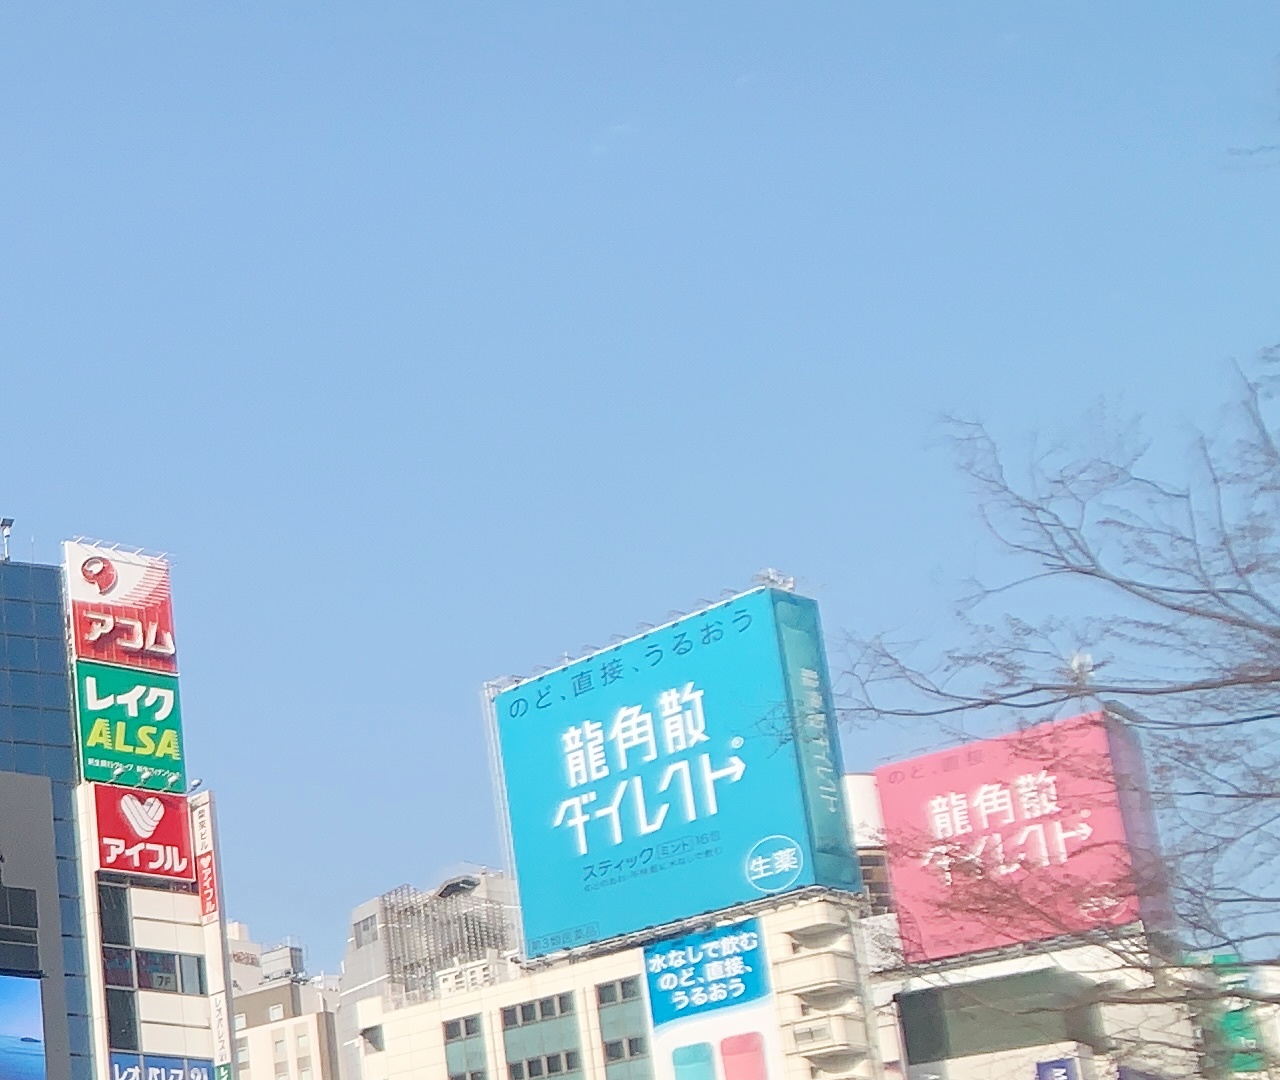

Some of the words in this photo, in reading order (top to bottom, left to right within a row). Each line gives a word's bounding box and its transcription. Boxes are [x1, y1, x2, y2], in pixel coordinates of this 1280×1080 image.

[83, 610, 176, 656] アコム
[509, 608, 754, 719] のど、直接、うるおう
[85, 676, 175, 722] レイク
[87, 717, 182, 761] ALSA
[560, 681, 710, 789] 龍角散
[551, 752, 748, 856] ダイレクト
[928, 769, 1061, 840] 龍角散
[102, 836, 188, 873] アイフル
[582, 847, 655, 882] スティック
[749, 848, 798, 882] 生薬
[201, 868, 216, 914] アイフル
[648, 932, 758, 972] 水なしで飲む
[156, 975, 171, 986] 7F
[660, 959, 753, 990] のど、直接、
[672, 981, 746, 1010] うるおう
